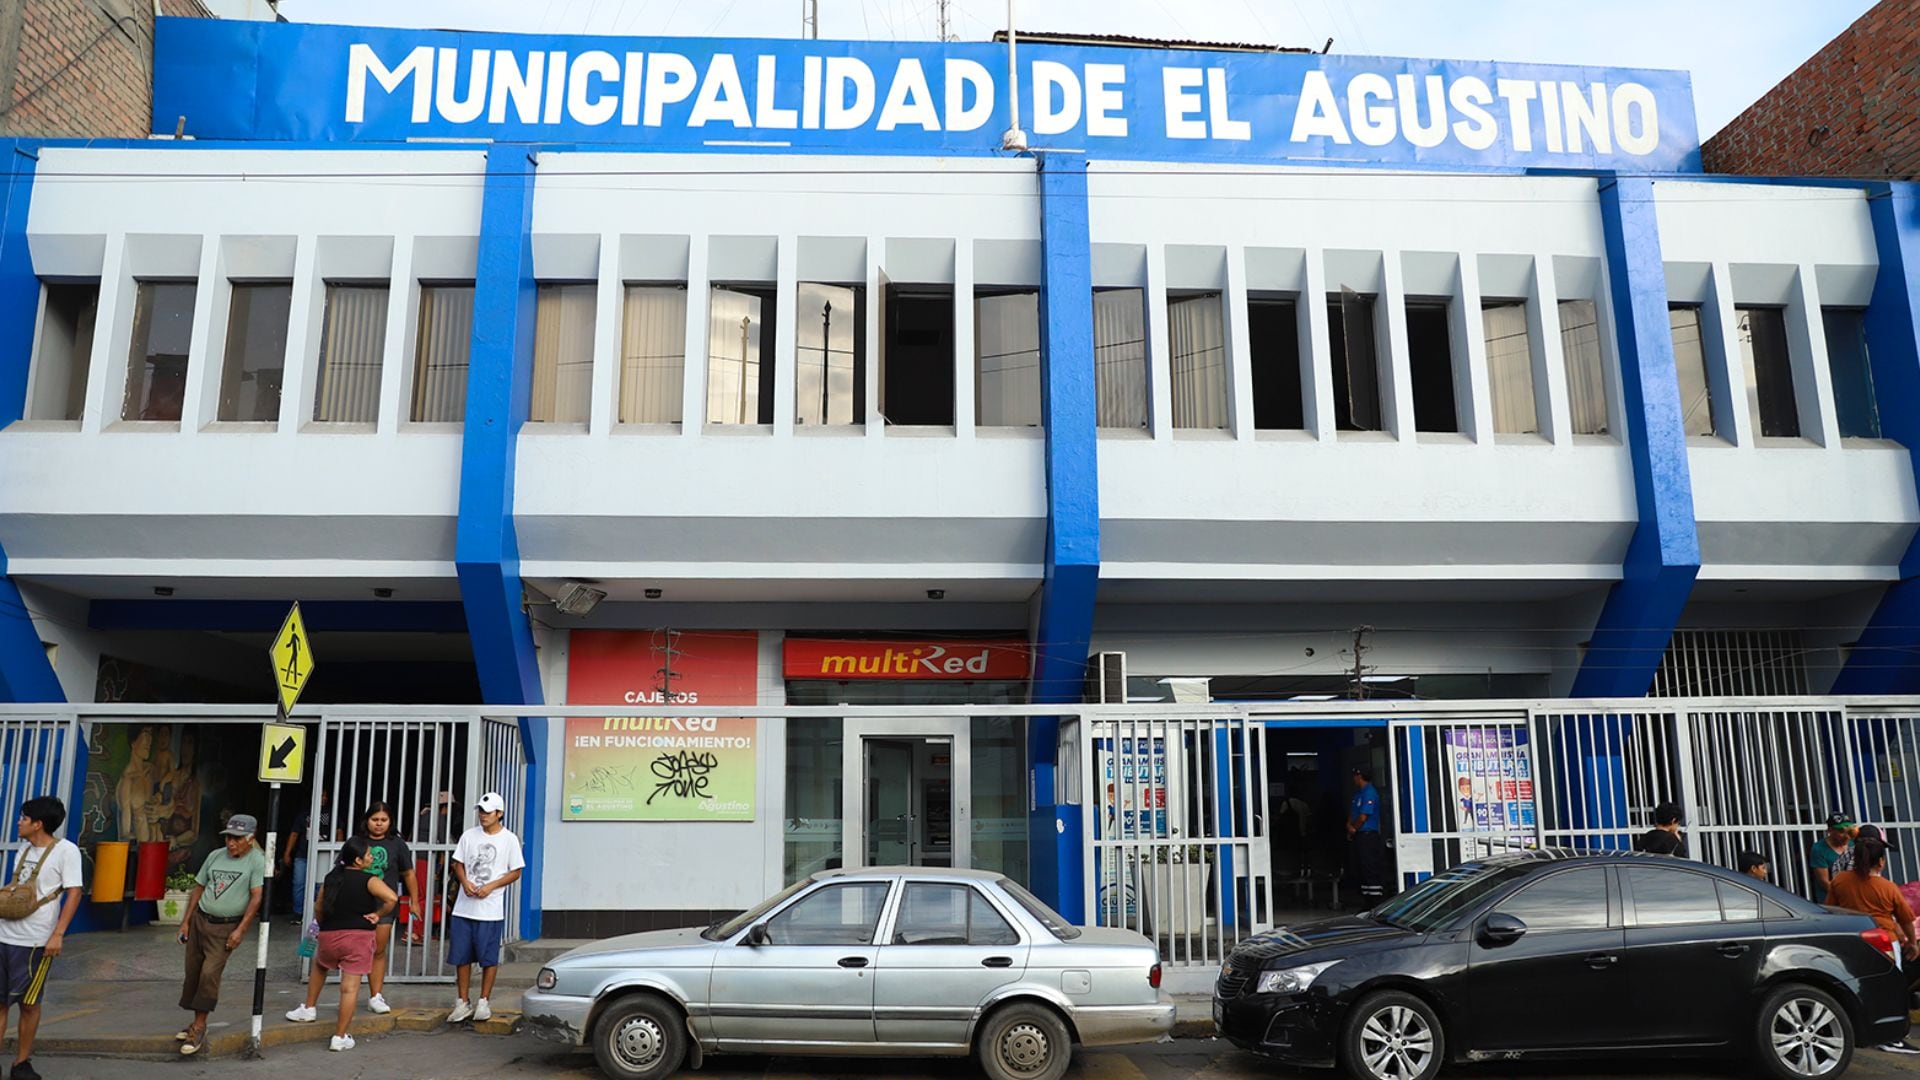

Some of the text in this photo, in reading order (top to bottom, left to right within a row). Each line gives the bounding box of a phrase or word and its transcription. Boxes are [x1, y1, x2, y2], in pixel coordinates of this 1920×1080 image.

[345, 43, 1659, 156] MUNICIPALIDAD DE EL AGUSTINO
[821, 645, 989, 673] multiRed
[575, 736, 750, 749] ¡EN FUNCIONAMIENTO!
[698, 800, 750, 812] Agustino
